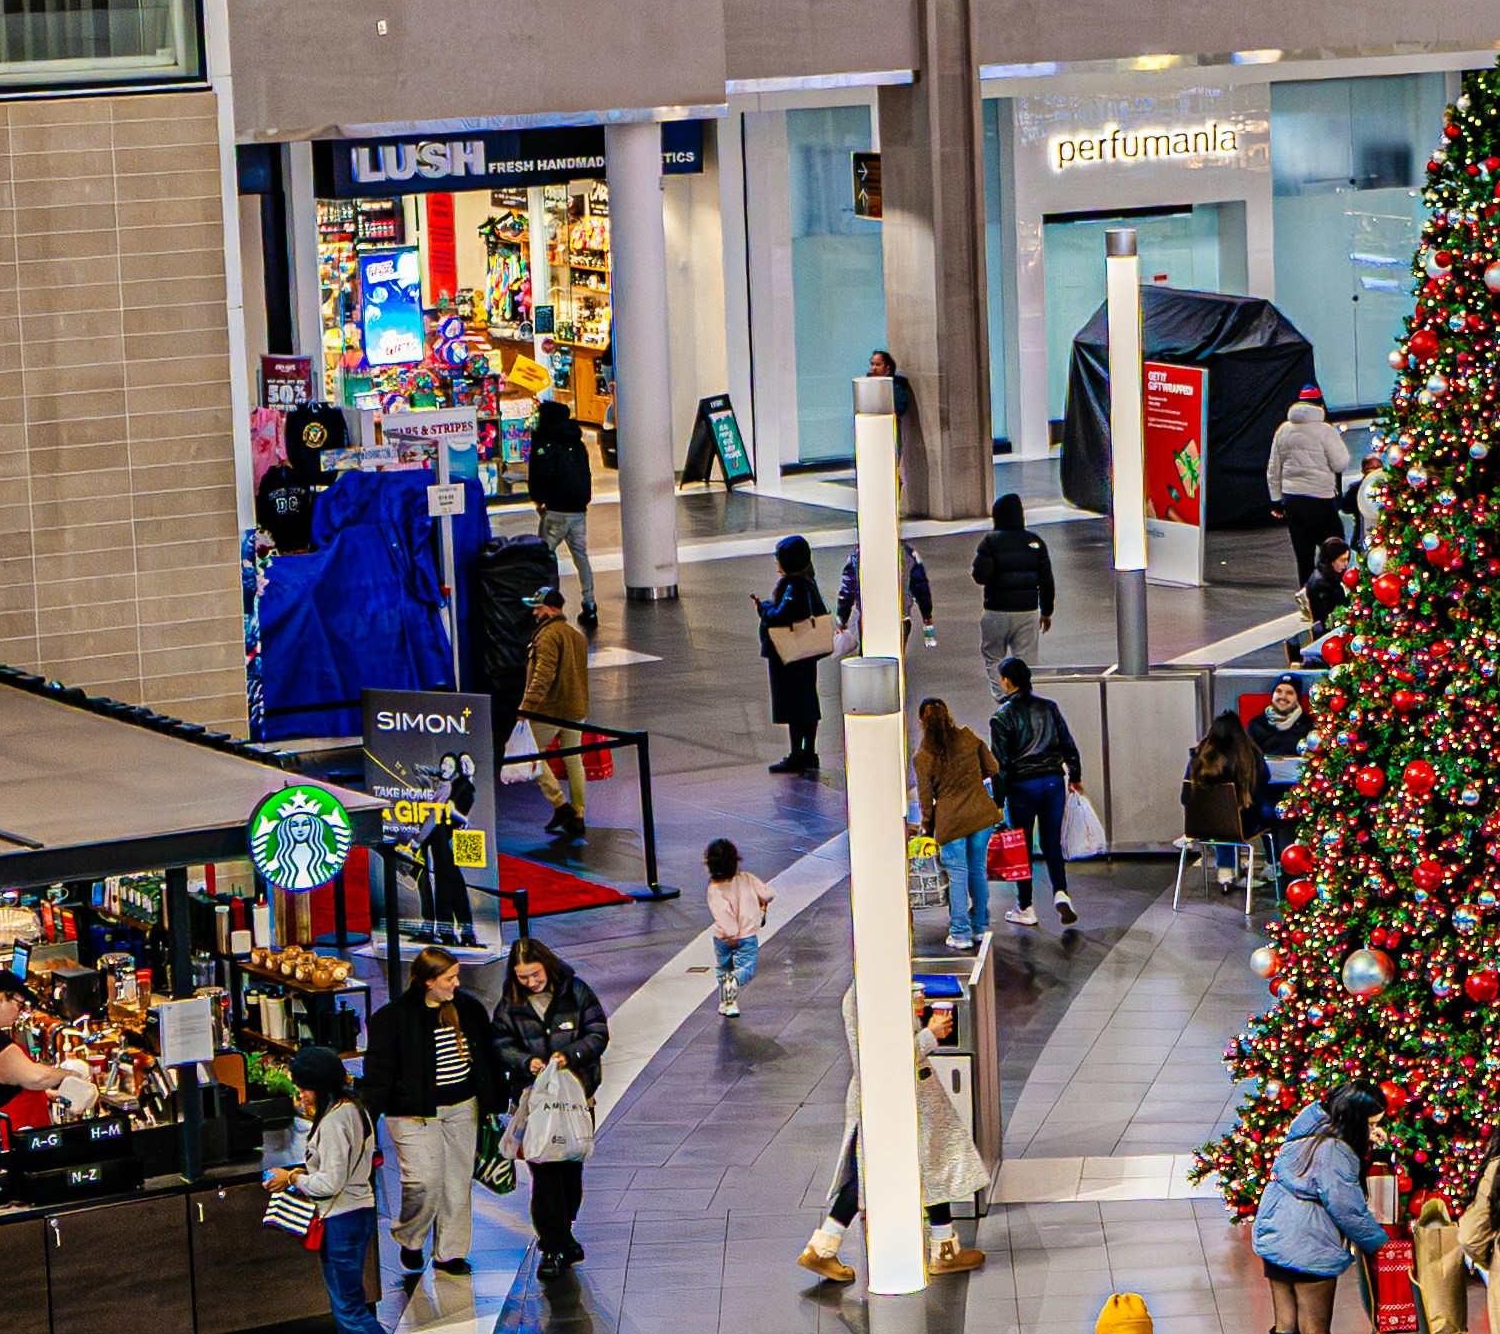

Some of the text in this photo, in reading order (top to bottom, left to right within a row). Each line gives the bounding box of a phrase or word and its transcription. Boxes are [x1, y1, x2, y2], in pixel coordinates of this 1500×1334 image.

[1056, 122, 1238, 169] perfumania
[350, 140, 486, 185] LUSH
[488, 158, 534, 174] FRESH
[537, 155, 605, 173] HANDMAD
[421, 424, 429, 436] &
[430, 421, 474, 435] STRIPES
[373, 785, 434, 800] TAKE HOME
[394, 799, 451, 826] GIFT!
[28, 1132, 59, 1150] A-G
[90, 1125, 122, 1140] H-M
[71, 1169, 98, 1185] N-Z
